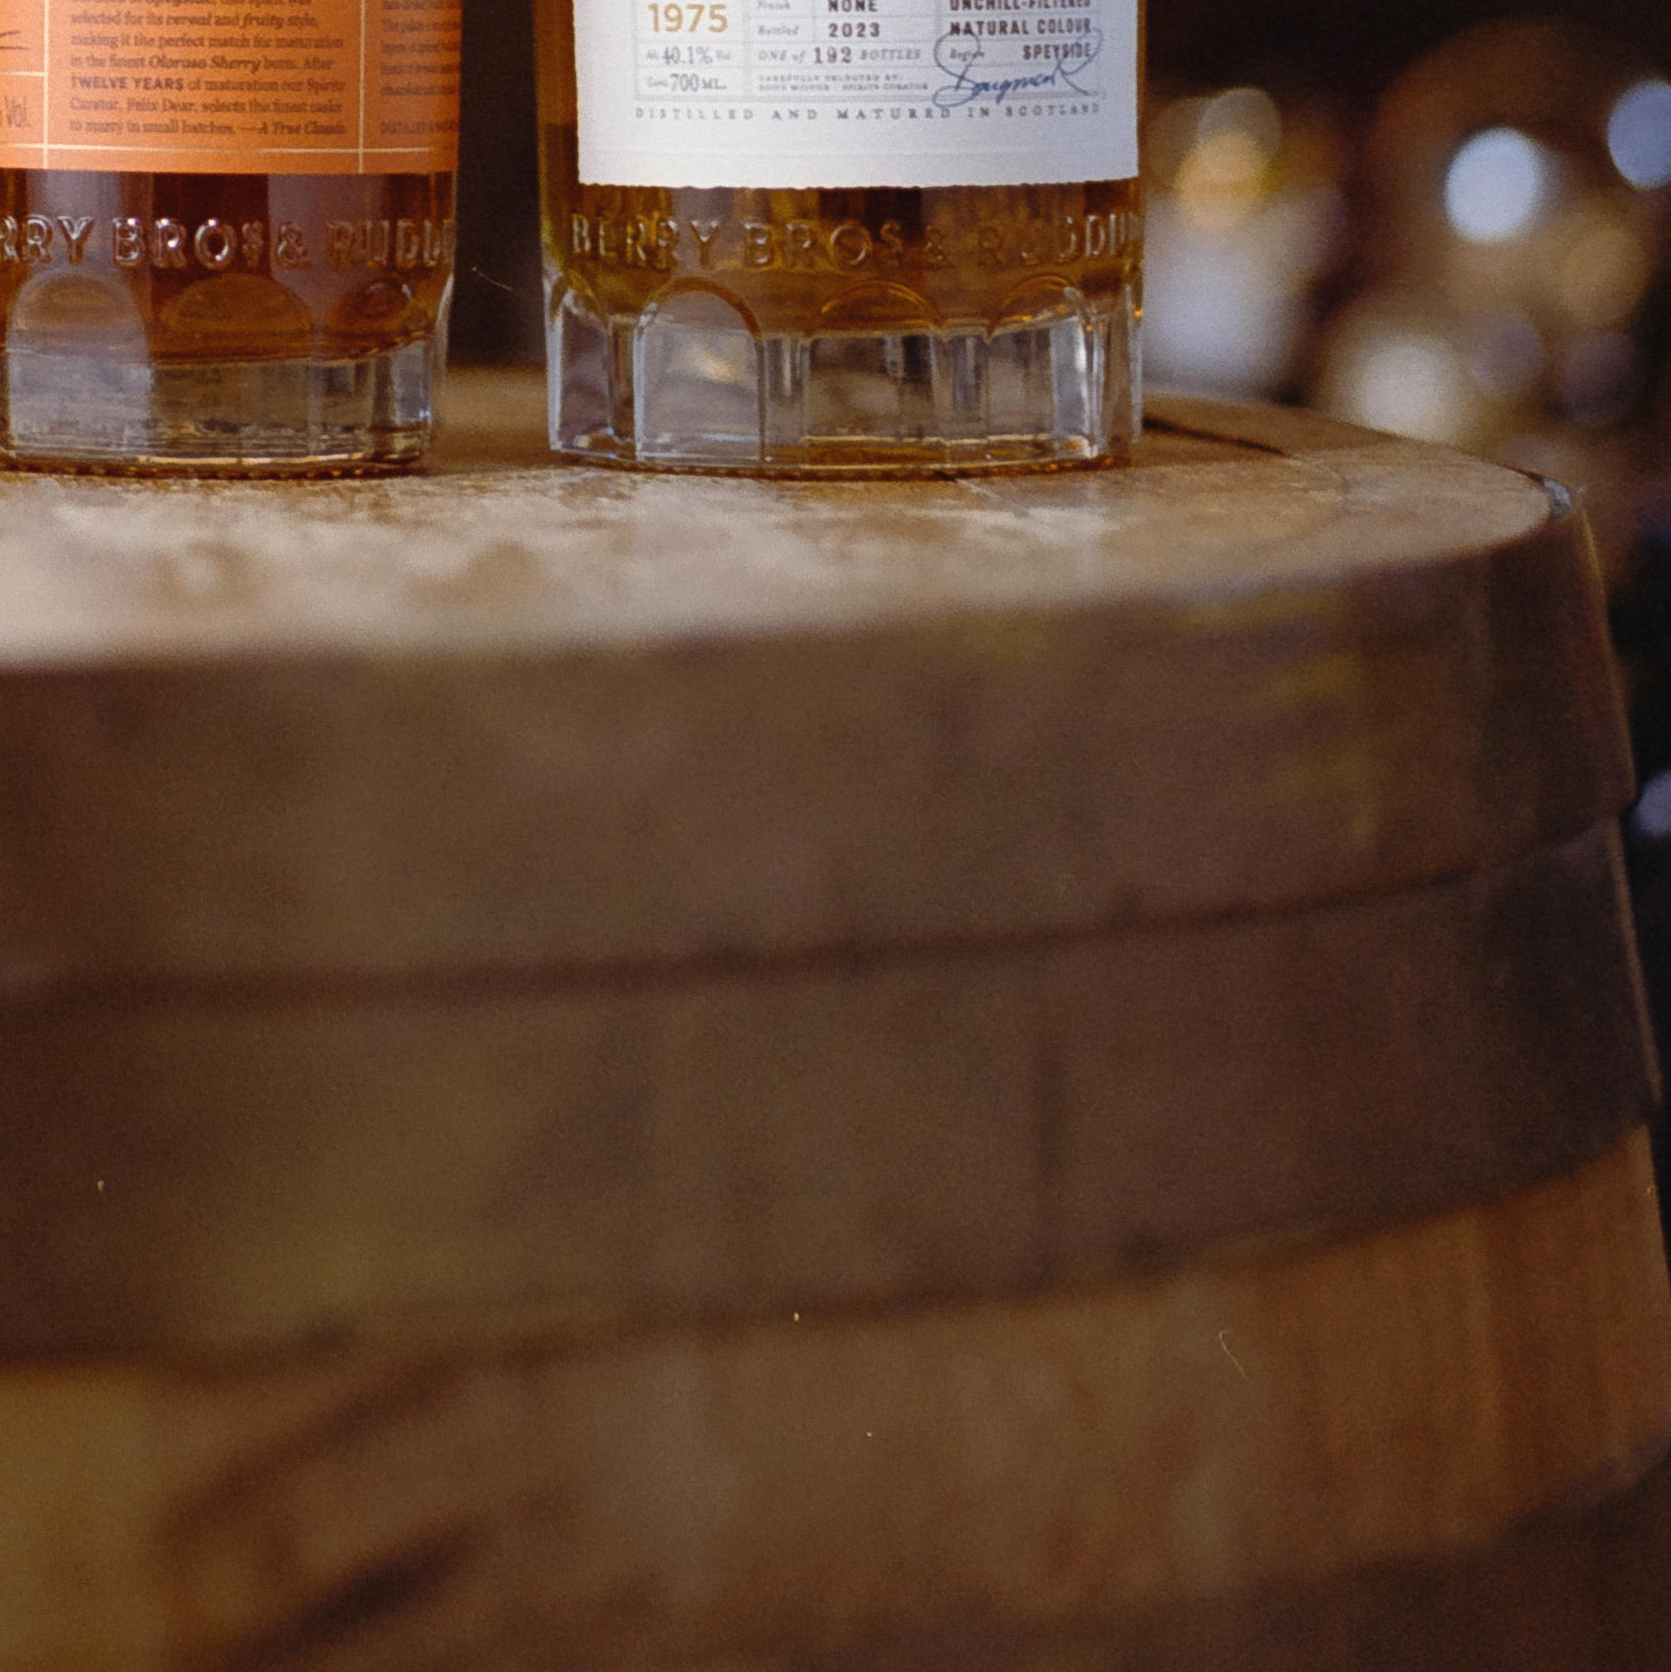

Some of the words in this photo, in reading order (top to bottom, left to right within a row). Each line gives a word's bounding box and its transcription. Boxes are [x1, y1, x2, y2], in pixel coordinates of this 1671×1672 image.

[647, 4, 728, 33] 1975
[828, 22, 881, 38] 2023
[950, 20, 1029, 35] NATURAL
[1037, 18, 1091, 34] COLOUR
[813, 46, 853, 64] 192
[1023, 43, 1091, 59] SPEYSIDE
